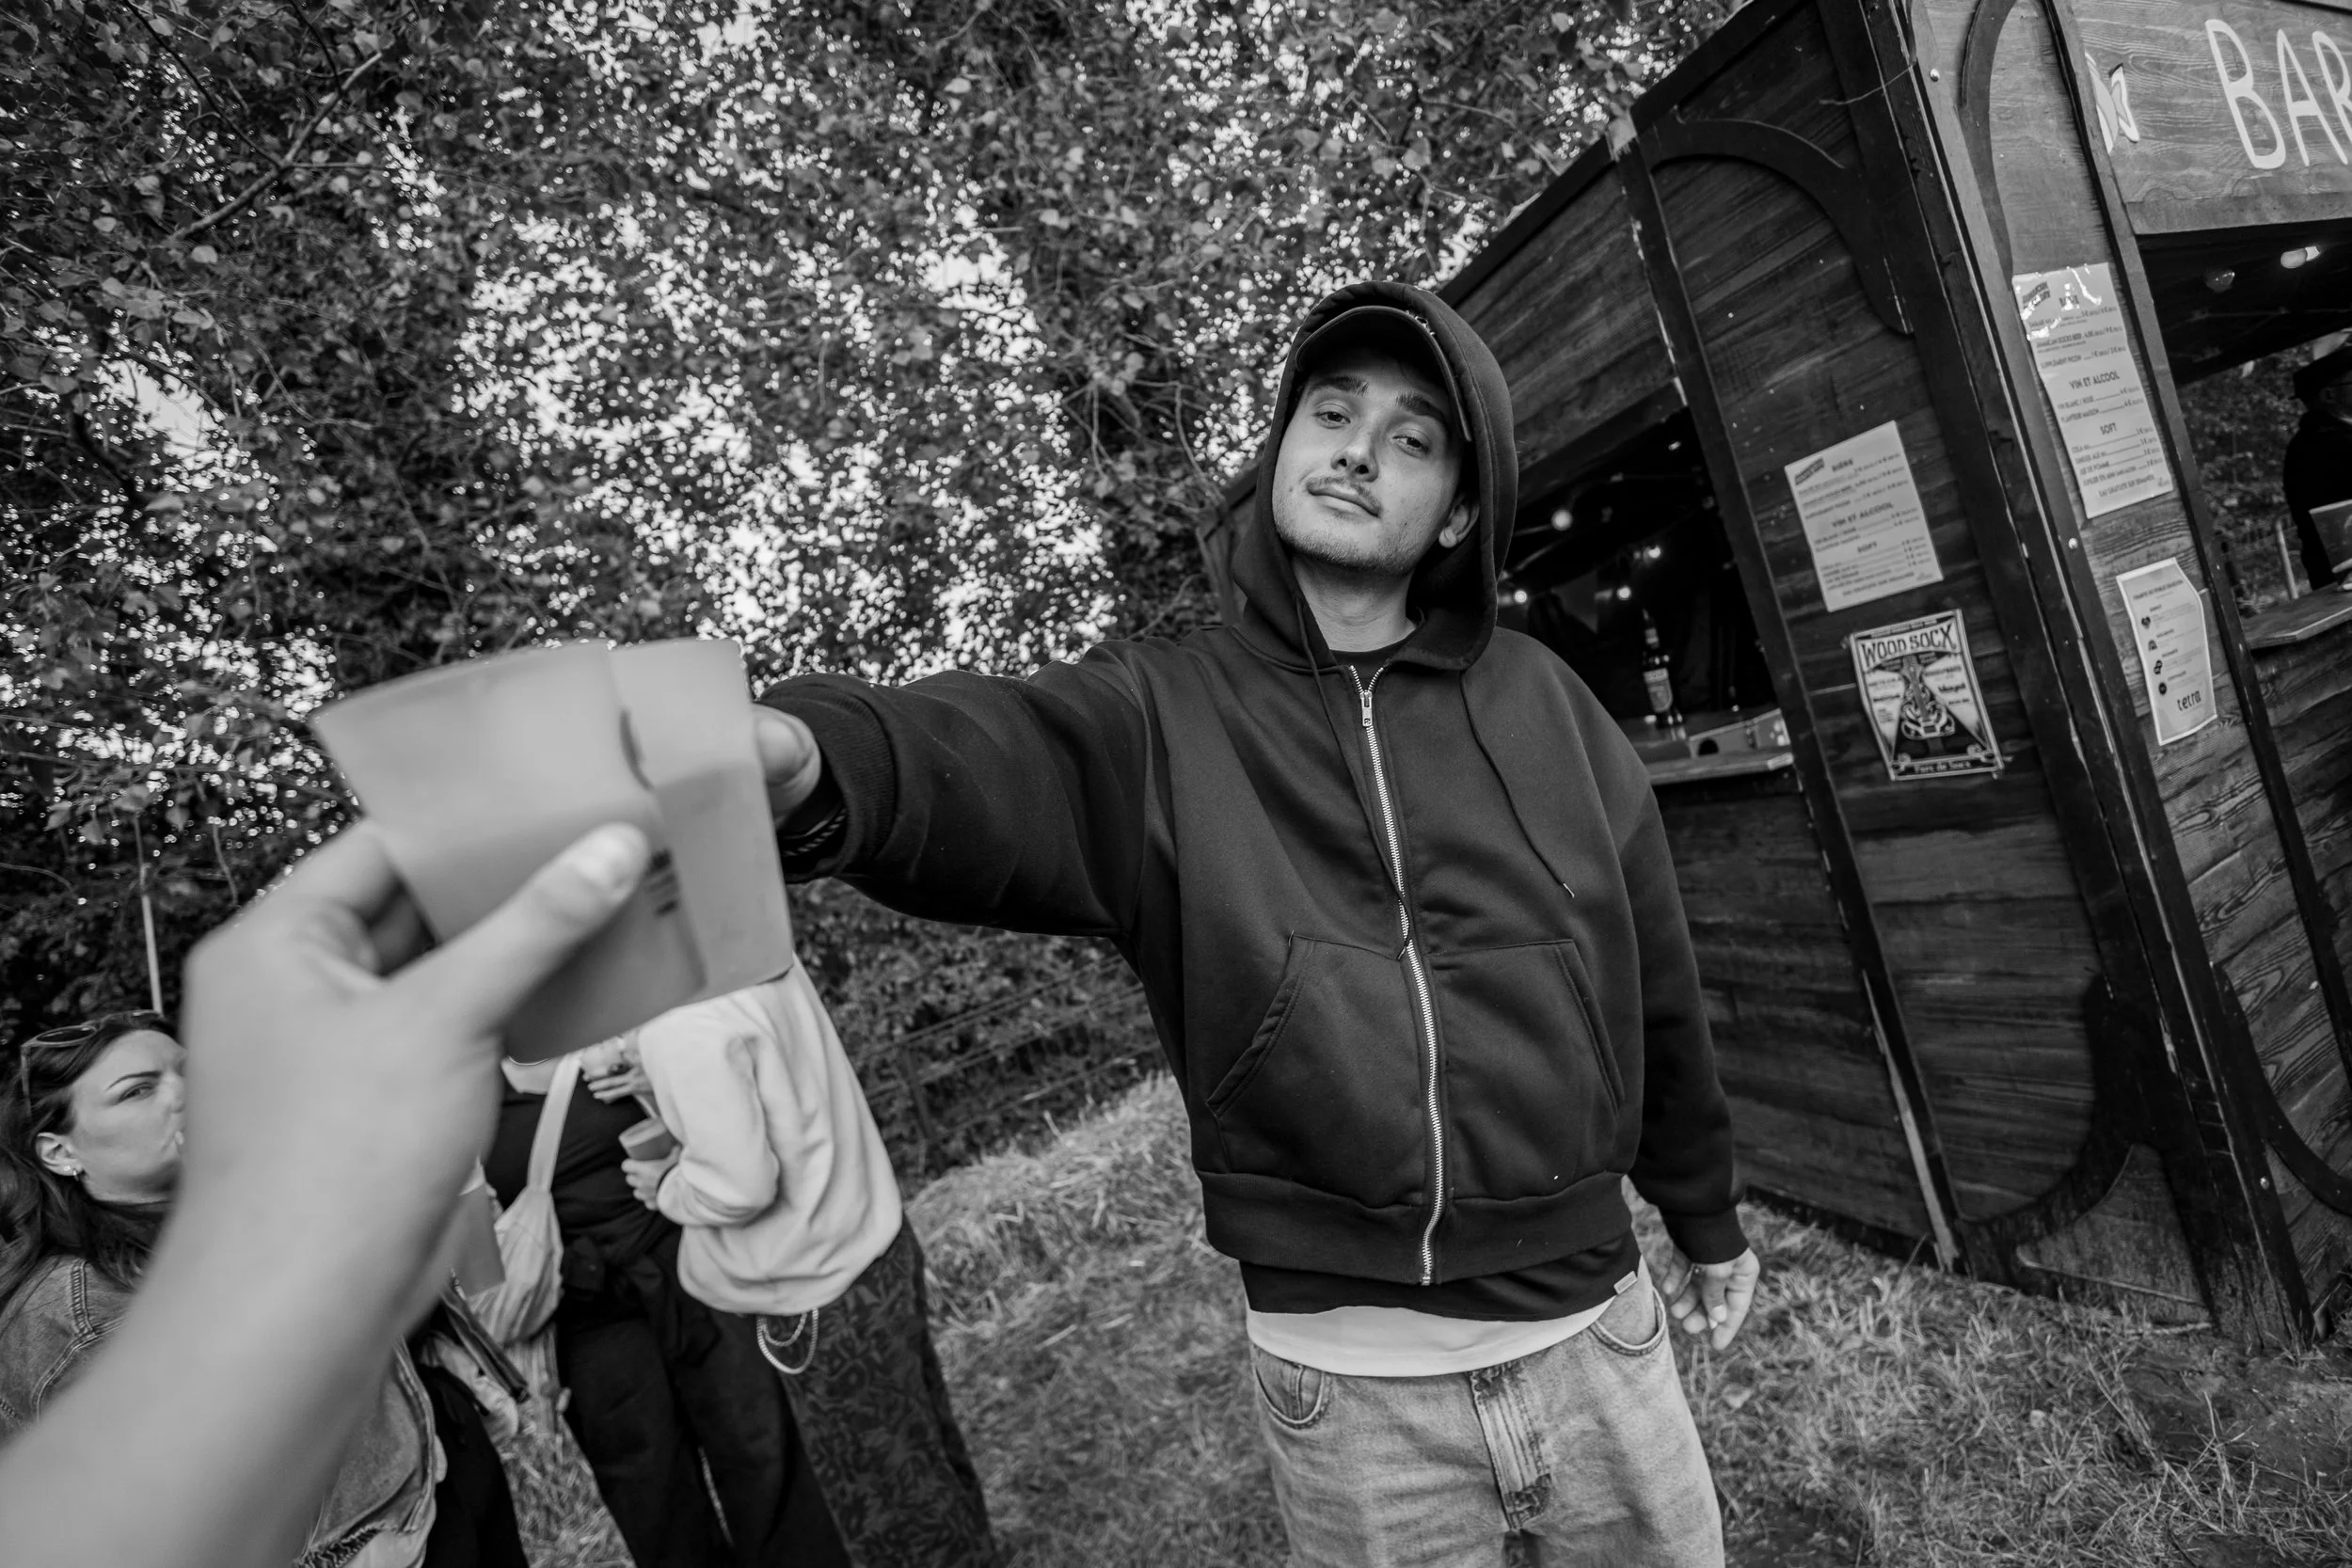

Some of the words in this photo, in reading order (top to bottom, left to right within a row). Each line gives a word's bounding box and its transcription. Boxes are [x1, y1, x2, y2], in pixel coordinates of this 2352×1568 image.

[2205, 19, 2352, 169] BAR
[2069, 379, 2083, 390] VIN
[2083, 376, 2090, 388] ET
[2092, 370, 2121, 385] ALCOOL
[2099, 422, 2118, 436] SOFT
[1859, 501, 1894, 519] ALCOOL
[1861, 638, 1907, 668] WOOD
[1909, 624, 1957, 651] SOCX
[2176, 690, 2202, 712] tetra
